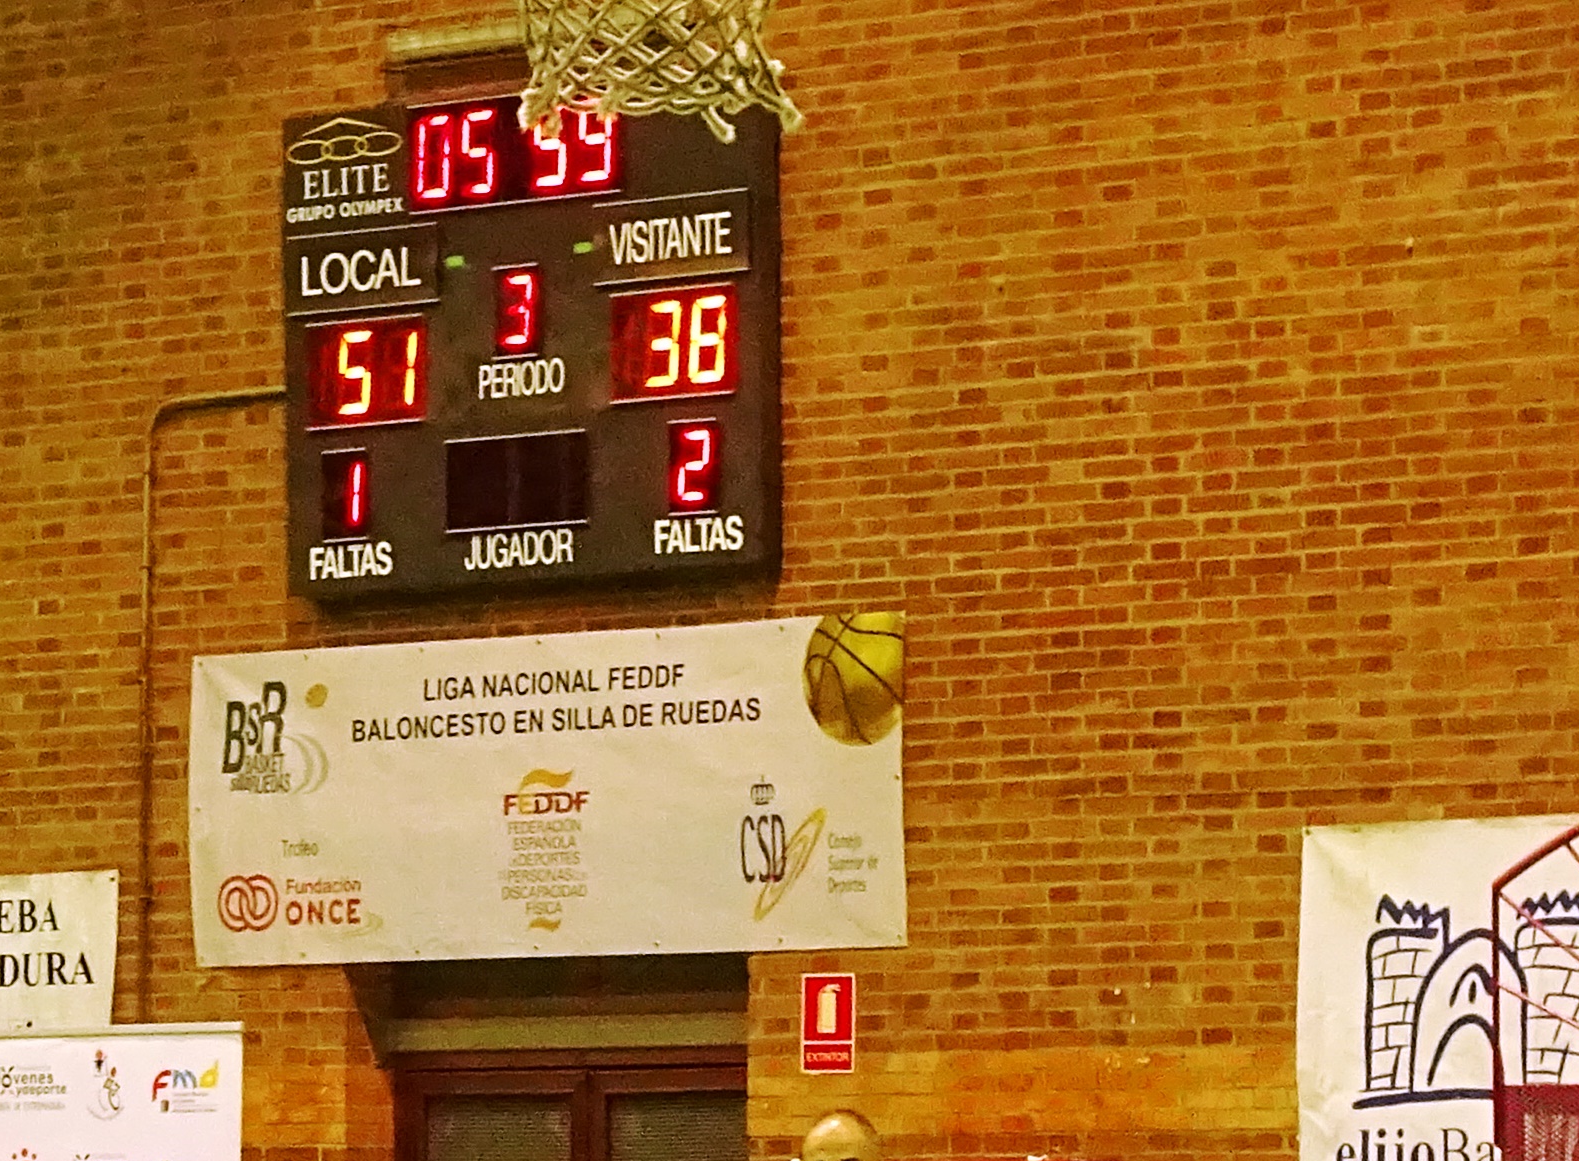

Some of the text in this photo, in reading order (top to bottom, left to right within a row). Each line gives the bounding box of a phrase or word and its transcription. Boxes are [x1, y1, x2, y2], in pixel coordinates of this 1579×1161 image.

[303, 164, 390, 200] ELITE
[286, 197, 404, 224] GRUPO OLYMPEX
[609, 211, 733, 265] VISITANTE
[301, 246, 422, 297] LOCAL
[501, 273, 533, 346] 3
[644, 294, 728, 388] 38
[338, 329, 419, 416] 51
[478, 358, 566, 400] PERIODO
[673, 429, 712, 502] 2
[347, 460, 363, 526] 1
[464, 528, 575, 571] JUGADOR
[654, 516, 744, 555] FALTAS
[309, 542, 393, 581] FALTAS
[423, 663, 685, 702] LIGA NACIONAL FEDDF
[352, 698, 762, 743] BALONCESTO EN SILLA DE RUEDAS
[503, 791, 590, 816] FEDDF
[741, 814, 787, 883] CSD
[285, 877, 362, 895] Fundación
[285, 899, 362, 926] ONCE
